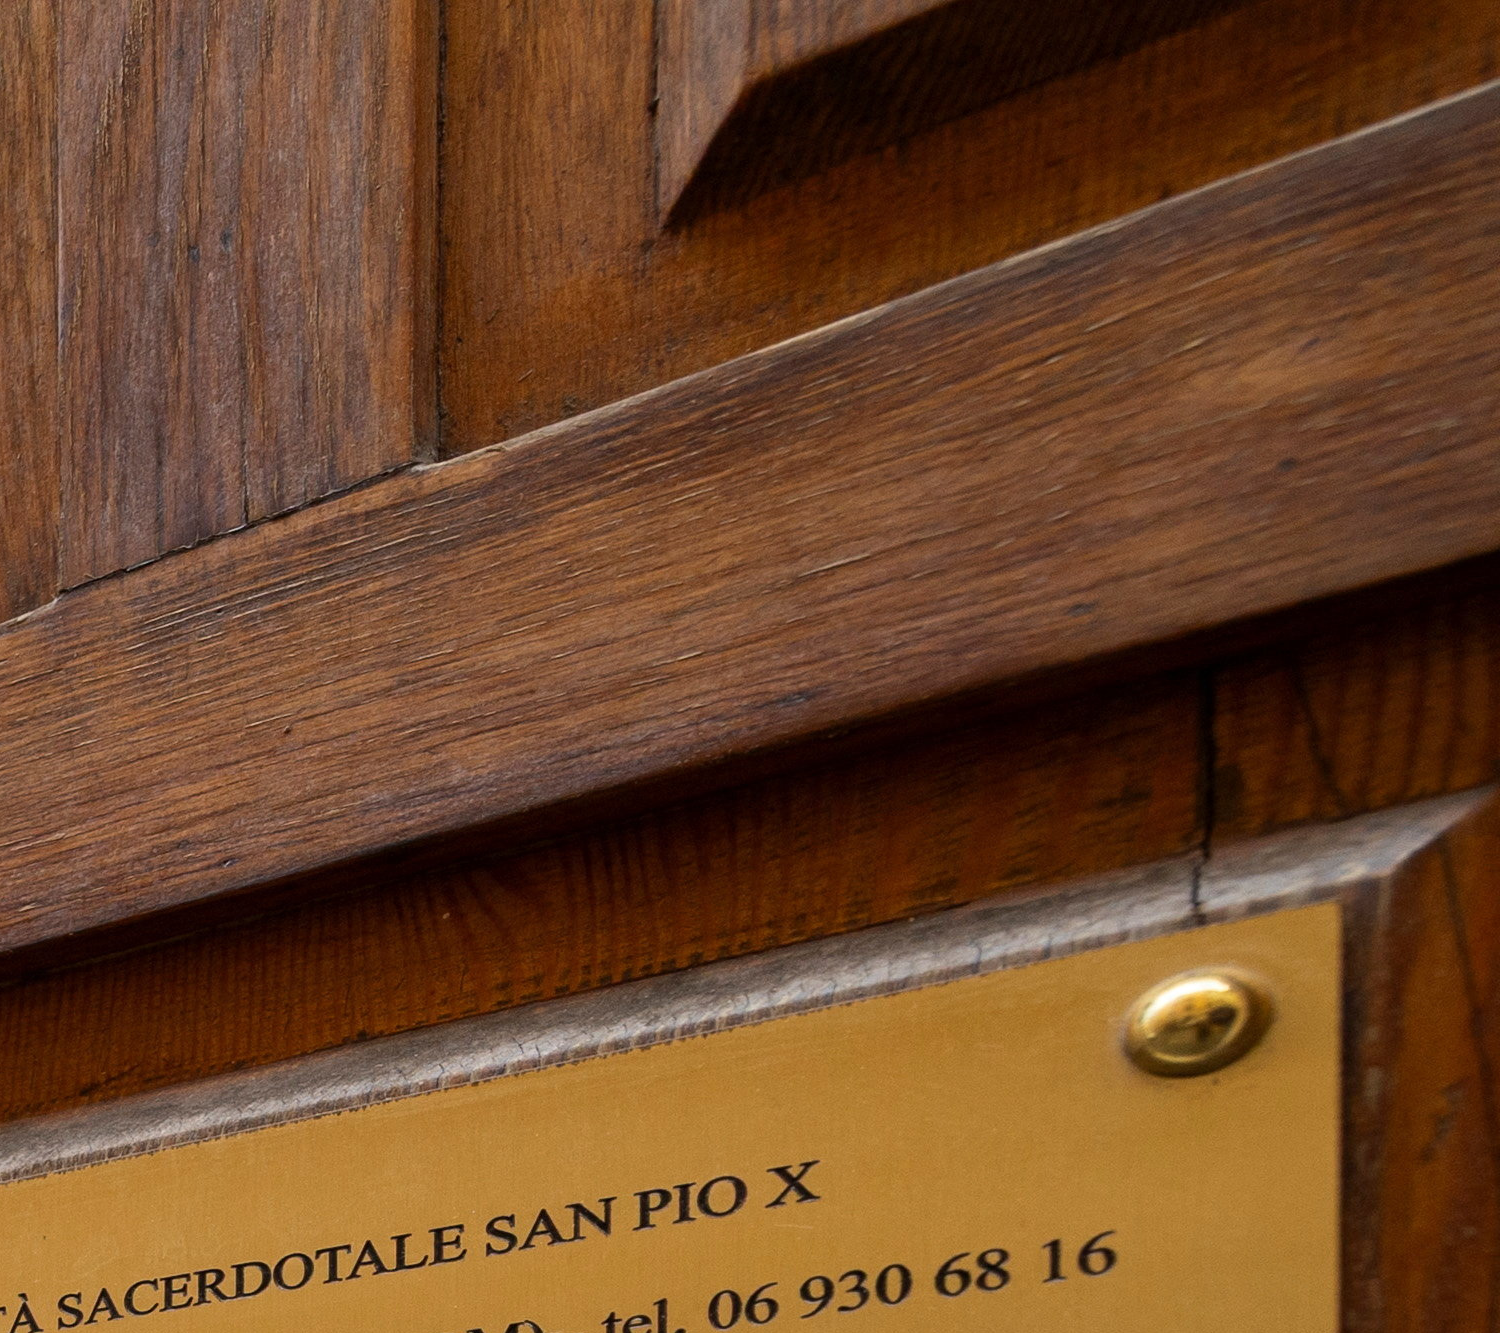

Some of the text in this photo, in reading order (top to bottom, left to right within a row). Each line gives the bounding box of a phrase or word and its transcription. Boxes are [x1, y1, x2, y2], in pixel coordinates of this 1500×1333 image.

[57, 1223, 468, 1331] SACERDOTALE
[485, 1196, 618, 1258] SAN
[632, 1175, 748, 1232] PIO
[764, 1159, 821, 1209] X
[707, 1281, 780, 1330] 06
[799, 1263, 914, 1320] 930
[933, 1247, 1011, 1298] 68
[1042, 1230, 1118, 1284] 16
